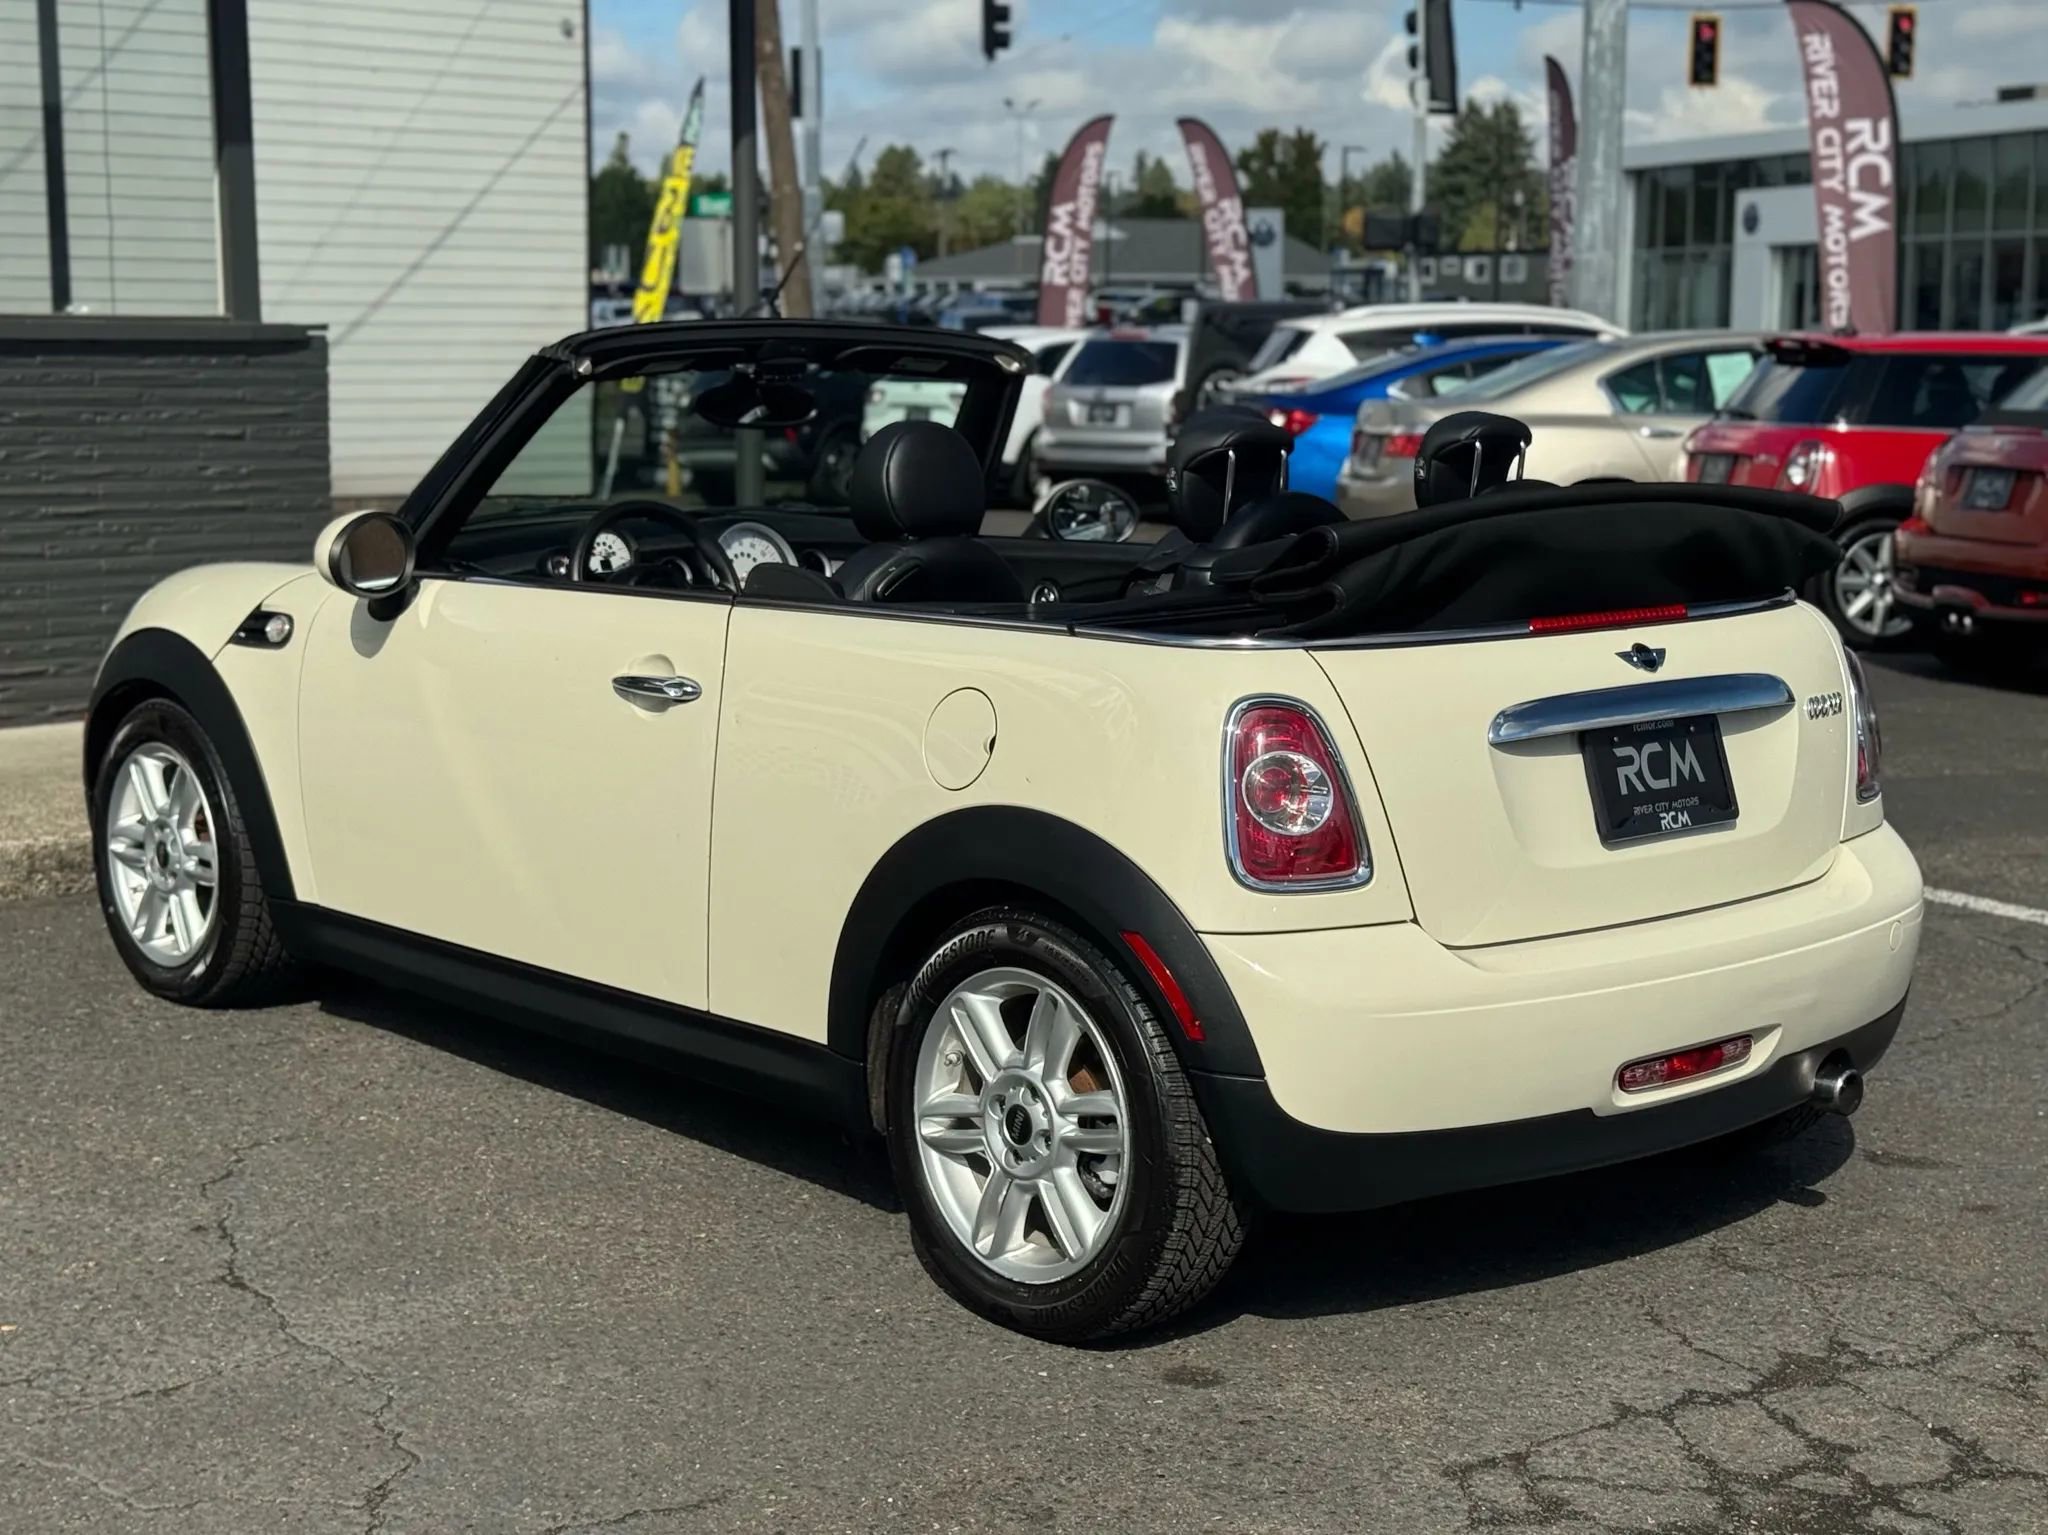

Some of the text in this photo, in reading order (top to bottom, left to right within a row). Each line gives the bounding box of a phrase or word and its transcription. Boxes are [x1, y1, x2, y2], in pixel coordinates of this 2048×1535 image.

[1803, 31, 1851, 328] RIVER CITY MOTORS
[1843, 117, 1892, 242] RCM
[1042, 201, 1076, 287] RCM
[1069, 236, 1091, 285] CITY
[1612, 738, 1706, 796] RCM
[1632, 796, 1700, 816] RIVER CITY MOTORS
[1659, 810, 1692, 831] RCM
